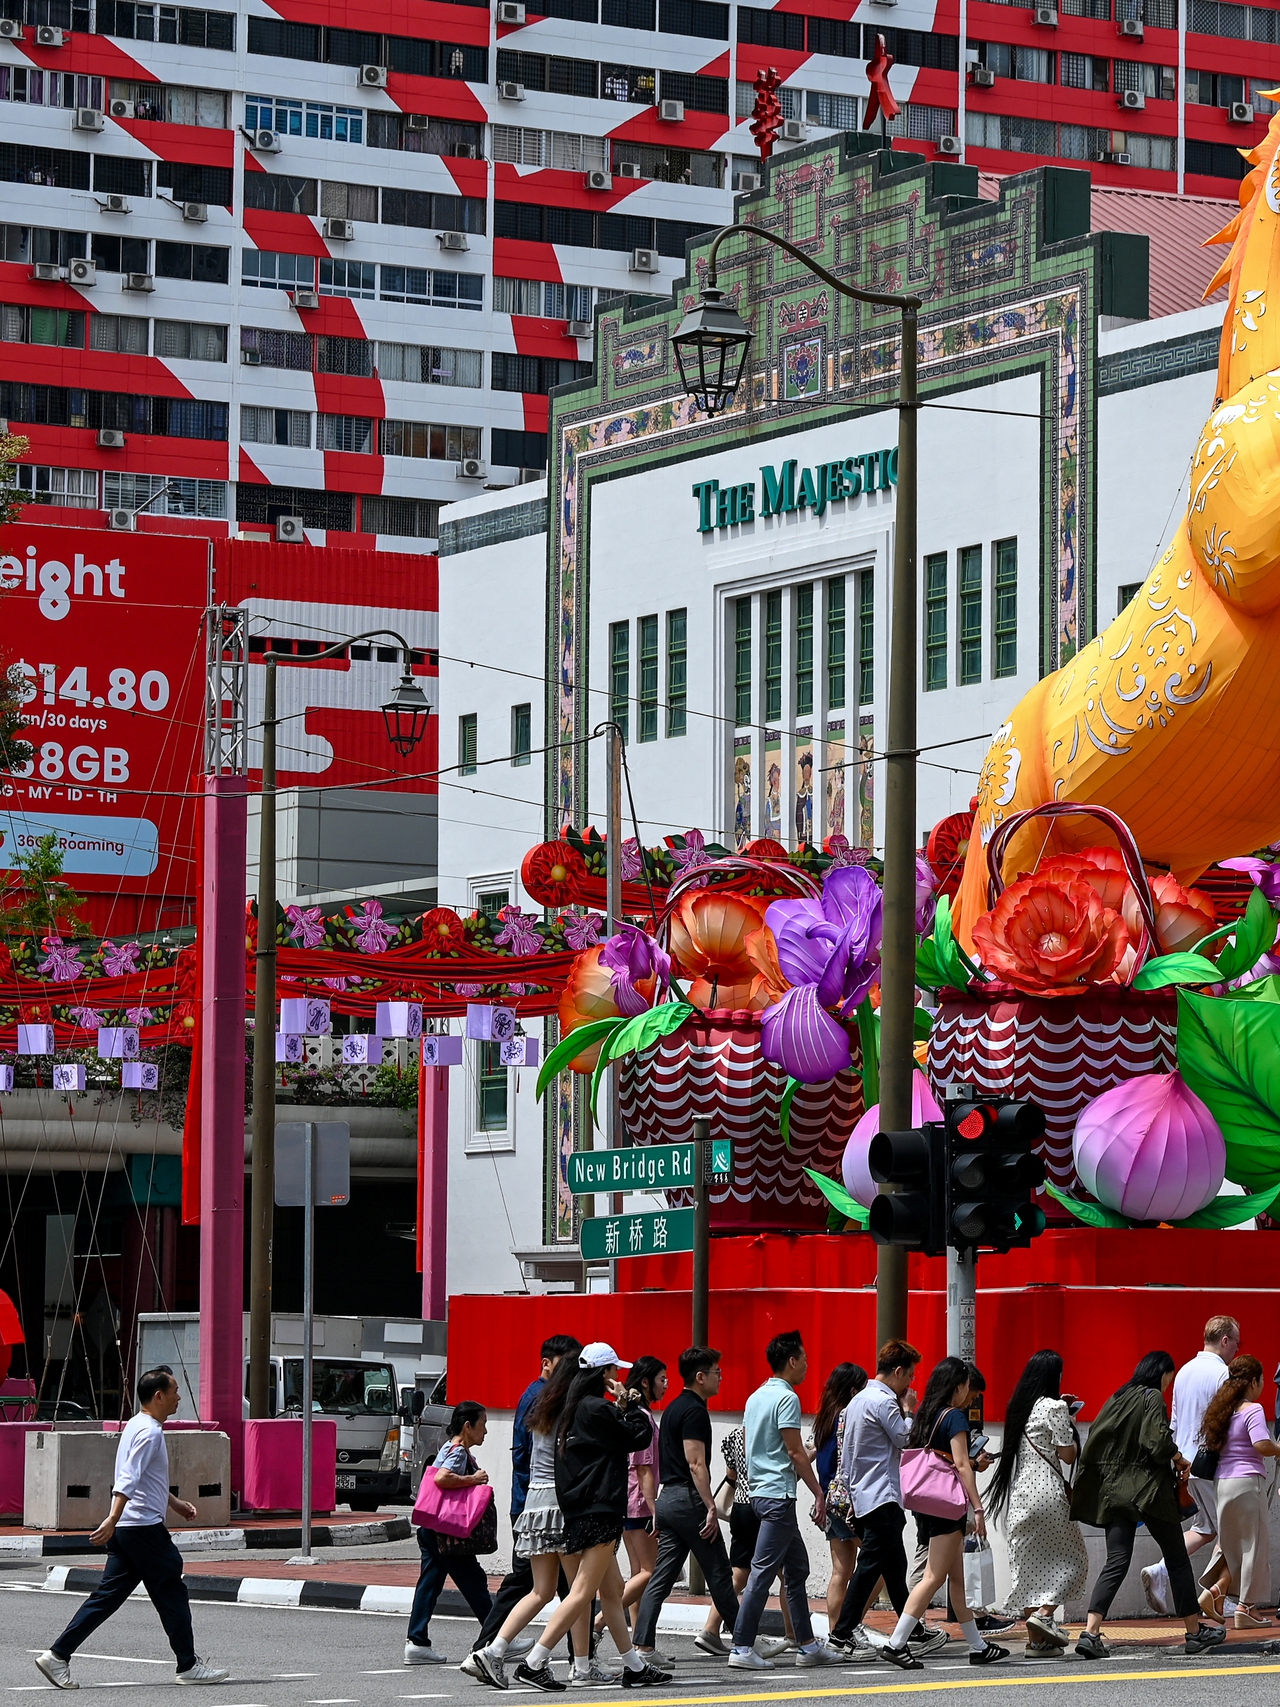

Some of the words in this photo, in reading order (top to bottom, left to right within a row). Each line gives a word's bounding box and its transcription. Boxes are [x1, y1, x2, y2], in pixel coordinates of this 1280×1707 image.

[6, 658, 170, 712] $14.80
[69, 715, 107, 733] days
[29, 785, 52, 800] MY
[68, 788, 83, 802] ID
[98, 790, 117, 803] TH
[59, 837, 124, 856] Roaming
[575, 1157, 606, 1183] New
[612, 1153, 665, 1184] Bridge
[672, 1150, 692, 1176] Rd
[605, 1216, 668, 1255] 新桥路
